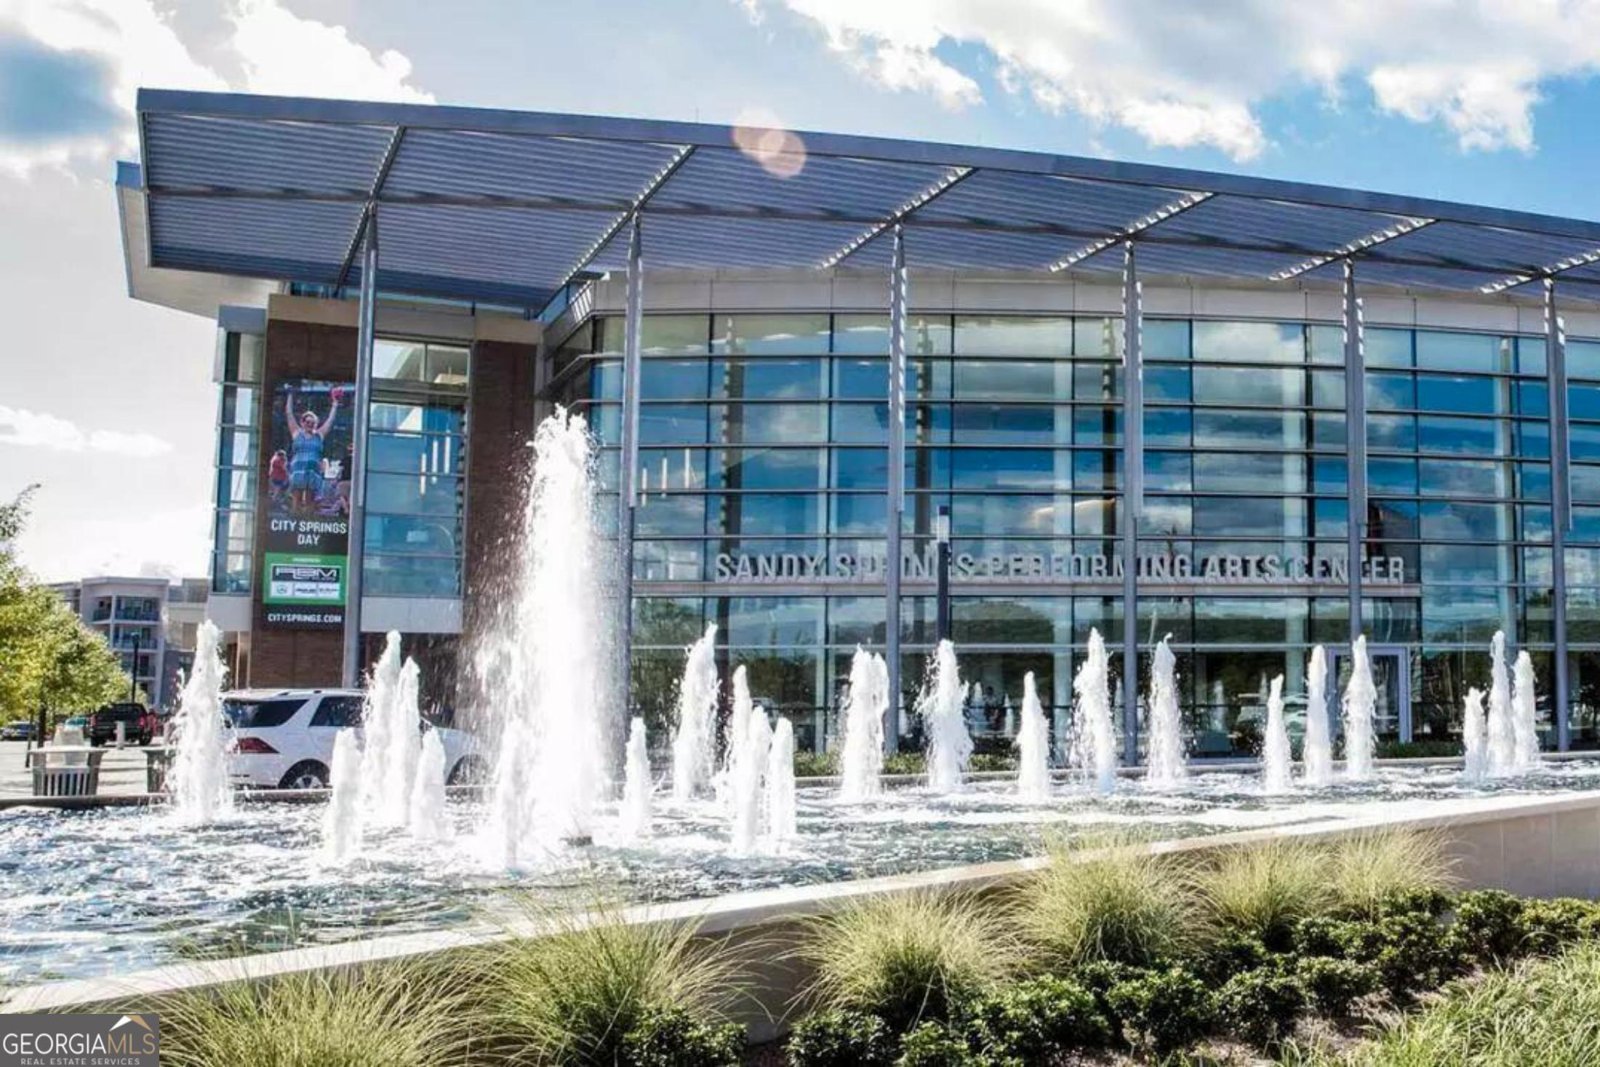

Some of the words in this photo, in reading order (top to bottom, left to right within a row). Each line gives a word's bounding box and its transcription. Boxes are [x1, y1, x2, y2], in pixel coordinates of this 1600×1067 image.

[271, 519, 297, 531] CITY
[299, 520, 347, 534] SPRINGS
[297, 534, 320, 545] DAY
[714, 553, 825, 582] SANDY
[1204, 554, 1280, 584] ARTS
[267, 613, 342, 623] CITYSPRINGS.COM
